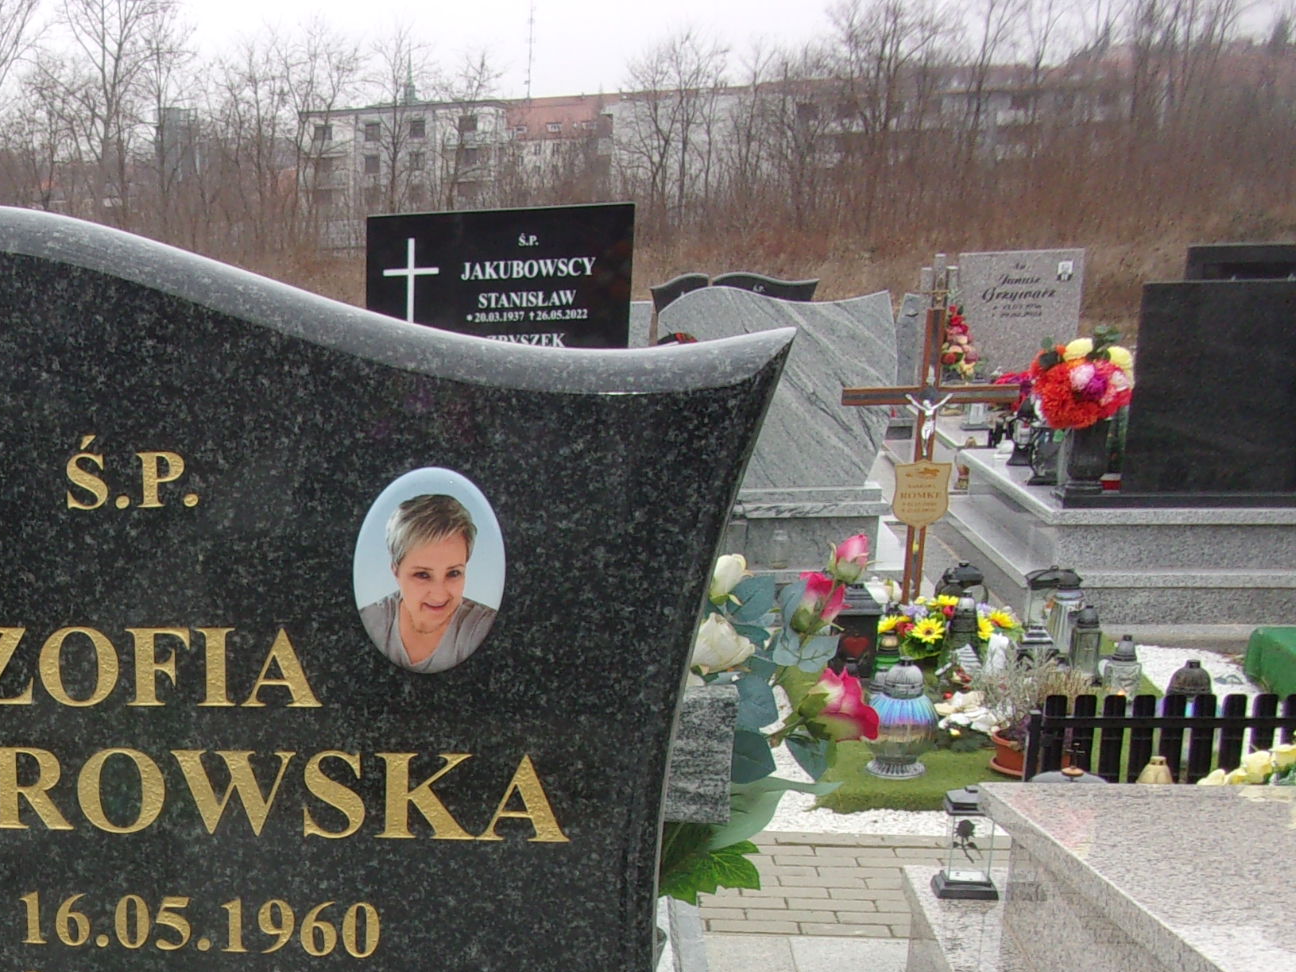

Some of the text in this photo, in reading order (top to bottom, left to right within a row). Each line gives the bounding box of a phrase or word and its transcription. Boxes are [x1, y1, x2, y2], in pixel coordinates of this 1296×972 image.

[461, 257, 596, 281] JAKUBOWSCY
[478, 289, 577, 309] STANISŁAW
[474, 308, 588, 323] 20.03.1937 26.05.2022
[67, 434, 200, 510] Ś.P.
[19, 891, 381, 959] 16.05.1960
